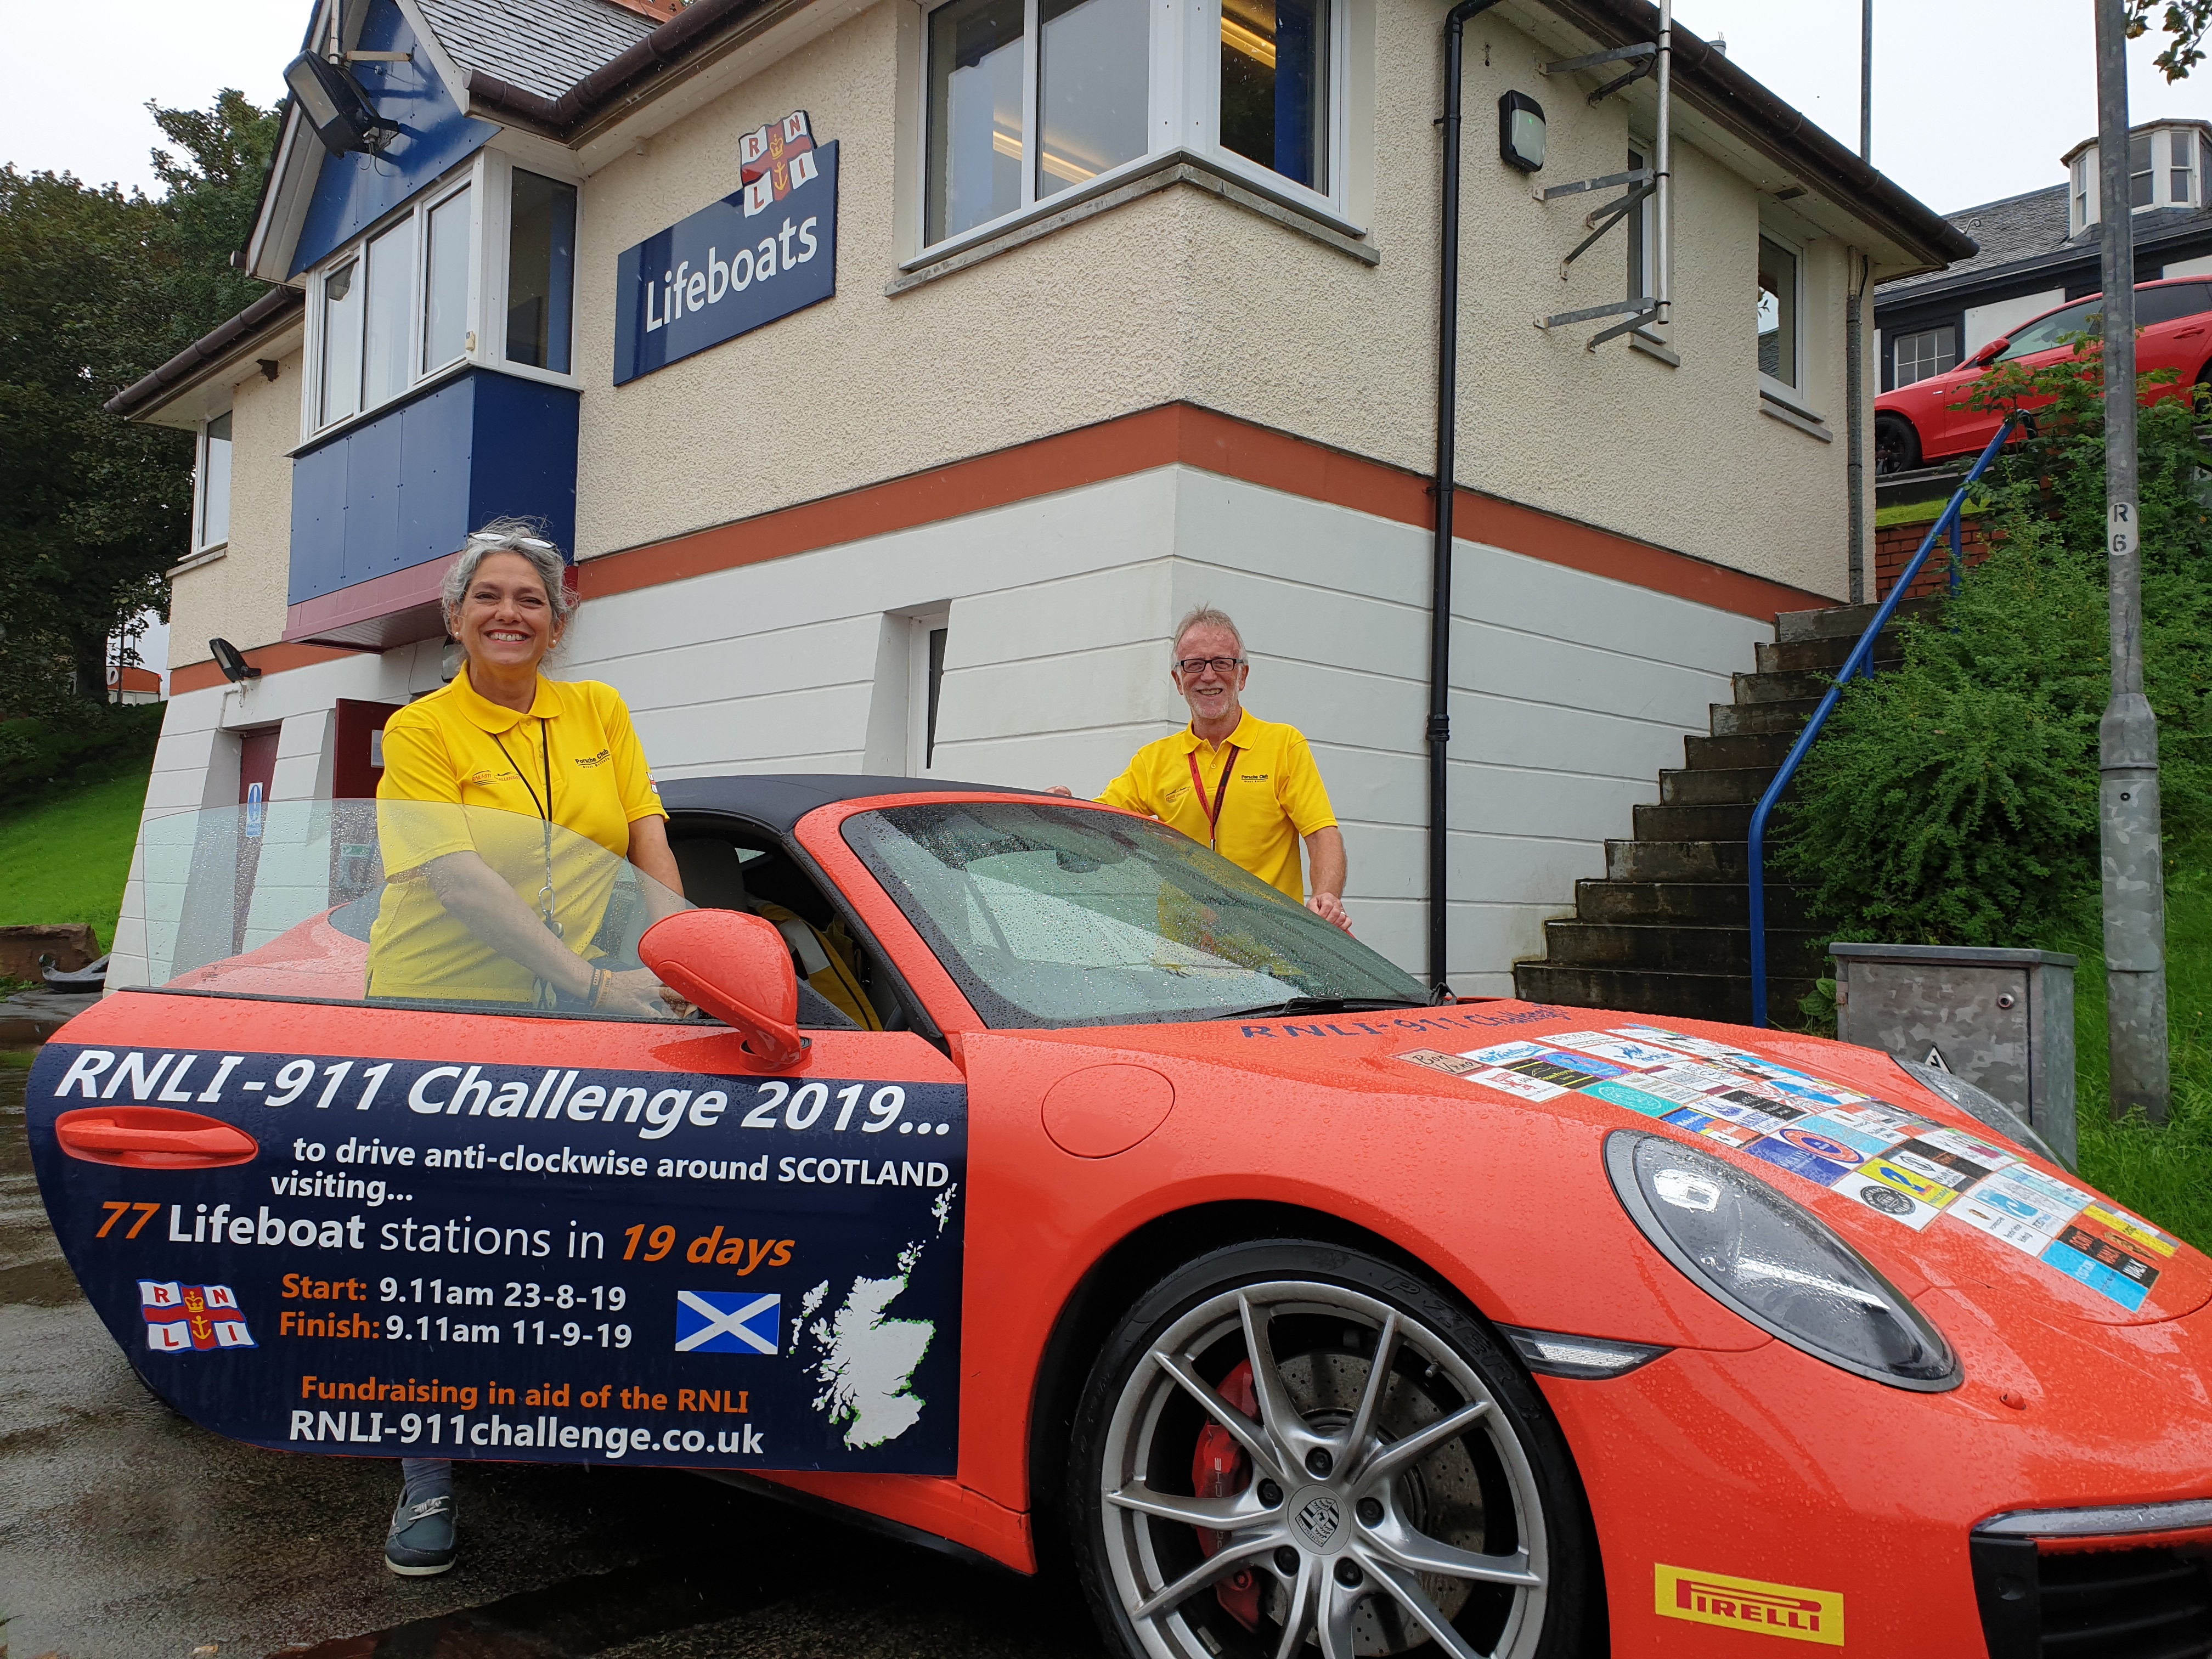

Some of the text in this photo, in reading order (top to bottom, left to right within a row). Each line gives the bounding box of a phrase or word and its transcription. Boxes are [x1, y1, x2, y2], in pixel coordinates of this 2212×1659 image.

[749, 116, 800, 157] R N
[753, 158, 805, 209] L I
[647, 217, 817, 332] Lifeboats
[2114, 504, 2128, 522] R
[2113, 533, 2127, 552] 6
[597, 749, 609, 759] Club
[1412, 1054, 1449, 1065] Bon
[54, 1050, 950, 1139] RNLI-911 Challenge 2019...
[294, 1137, 950, 1188] to drive anti-clockwise around SCOTLAND
[271, 1170, 414, 1206] visiting...
[95, 1201, 795, 1276] 77 Lifeboat stations in 19 days
[2122, 1258, 2148, 1279] WALK
[154, 1286, 229, 1305] R N
[281, 1273, 627, 1312] Start: 9.11am 23-8-19
[164, 1325, 238, 1347] L I
[279, 1312, 632, 1348] Finish: 9.11am 11-9-19
[301, 1375, 749, 1413] Fundraising in aid of the RNLI
[290, 1410, 763, 1457] RNLI-911challenge.co.uk
[1676, 1578, 1822, 1632] PIRELLI
